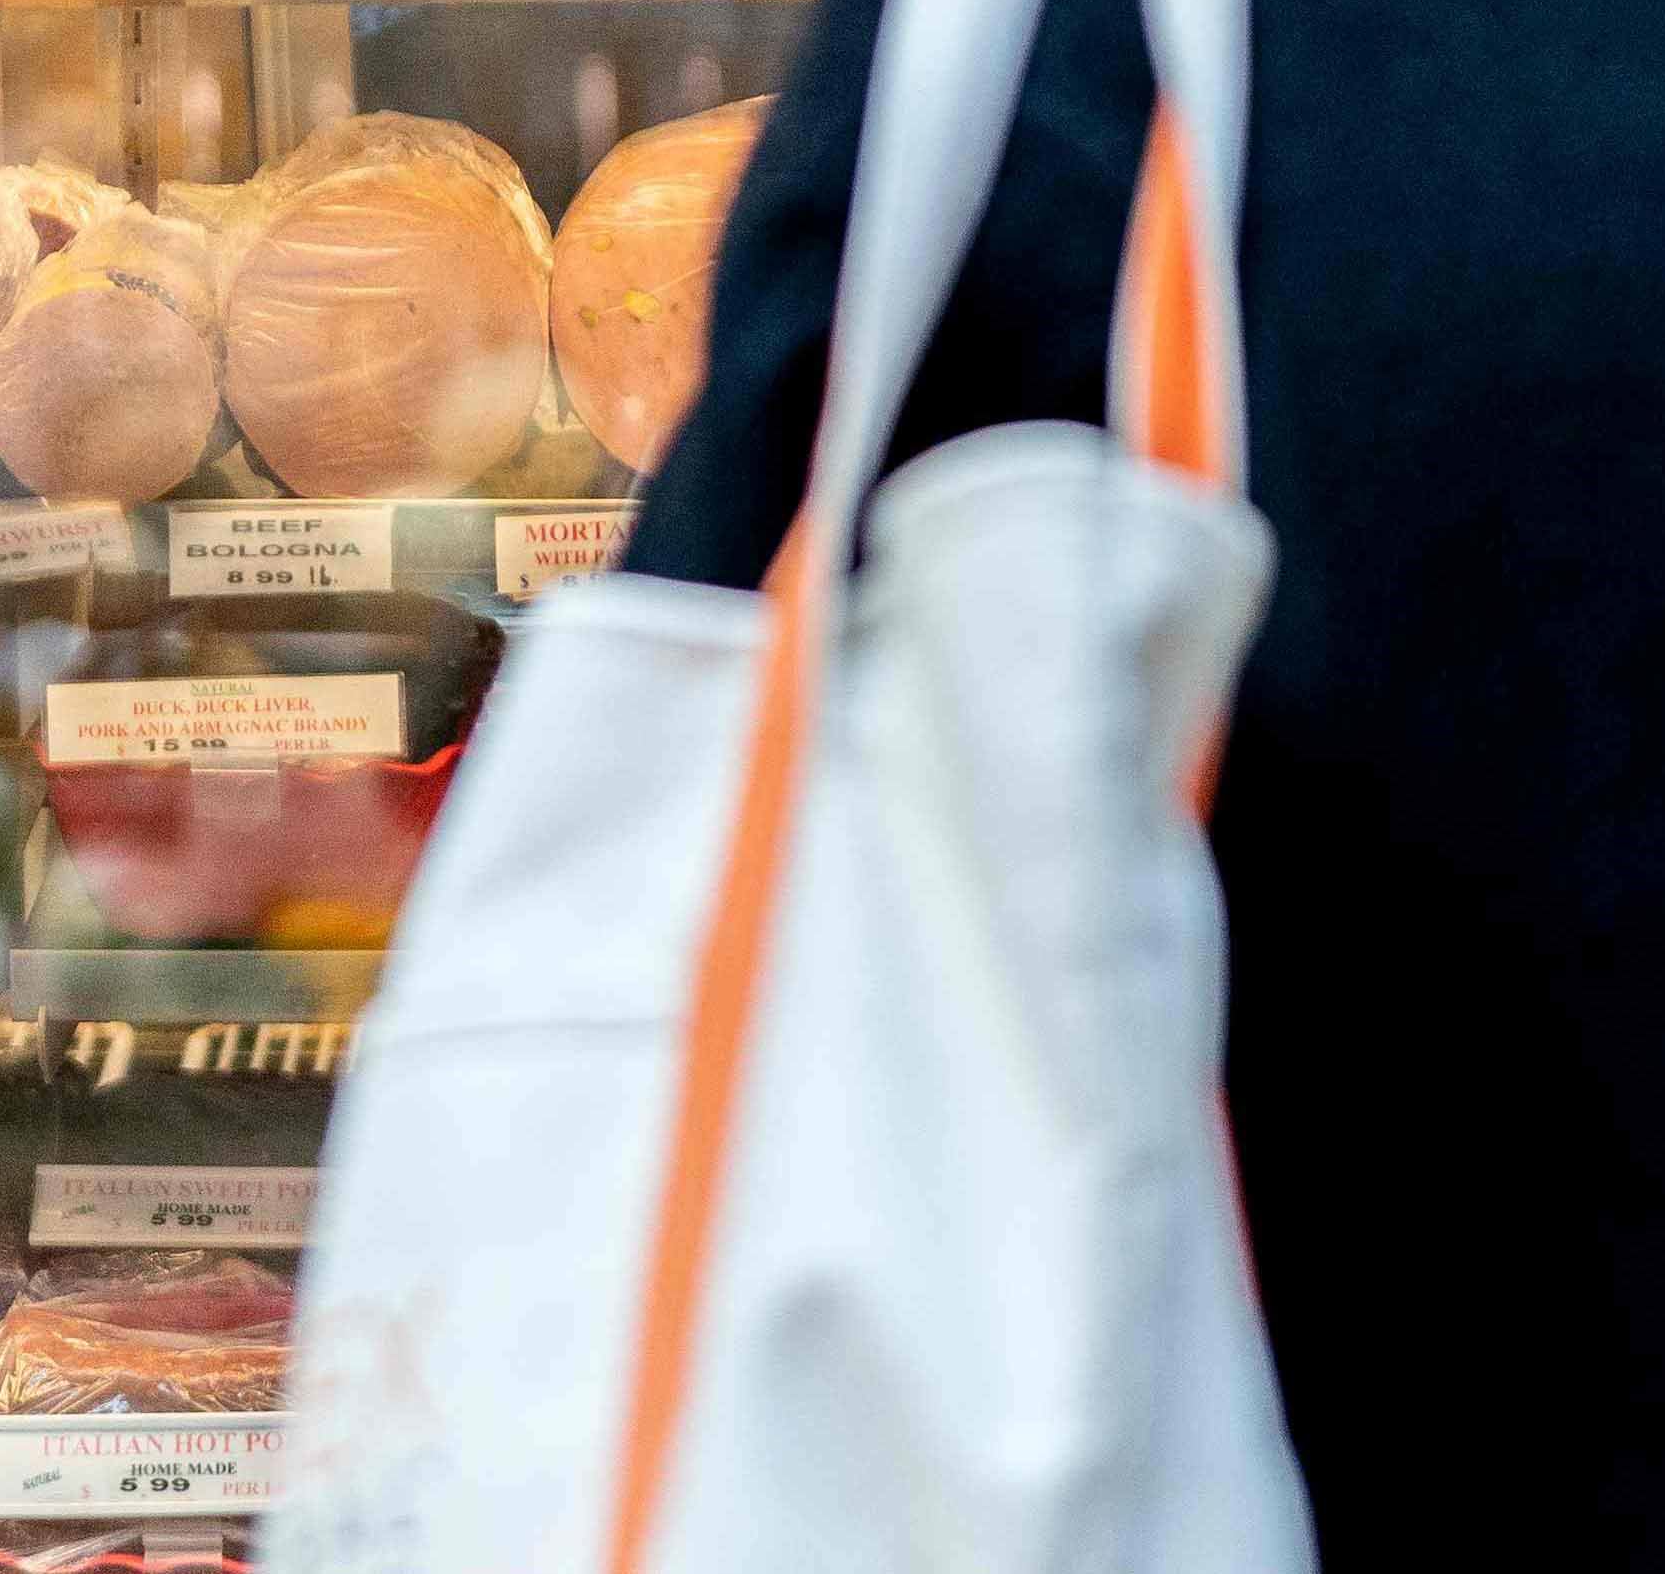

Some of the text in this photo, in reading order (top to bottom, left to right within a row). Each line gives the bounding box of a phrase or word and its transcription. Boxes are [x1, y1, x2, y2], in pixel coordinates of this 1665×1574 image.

[231, 518, 323, 534] BEEF
[185, 542, 362, 559] BOLOGNA
[534, 549, 587, 567] WITH
[190, 681, 256, 695] NATURAL
[132, 697, 316, 717] DUCK, DUCK LIVER,
[77, 716, 371, 739] PORK AND ARMAGNAC BRANDY
[64, 1179, 266, 1198] ITALIAN SWEET
[157, 1202, 253, 1216] HOME MADE
[41, 1432, 235, 1457] ITALIAN HOT
[130, 1461, 239, 1477] HOME MADE
[21, 1469, 62, 1491] NATURAL
